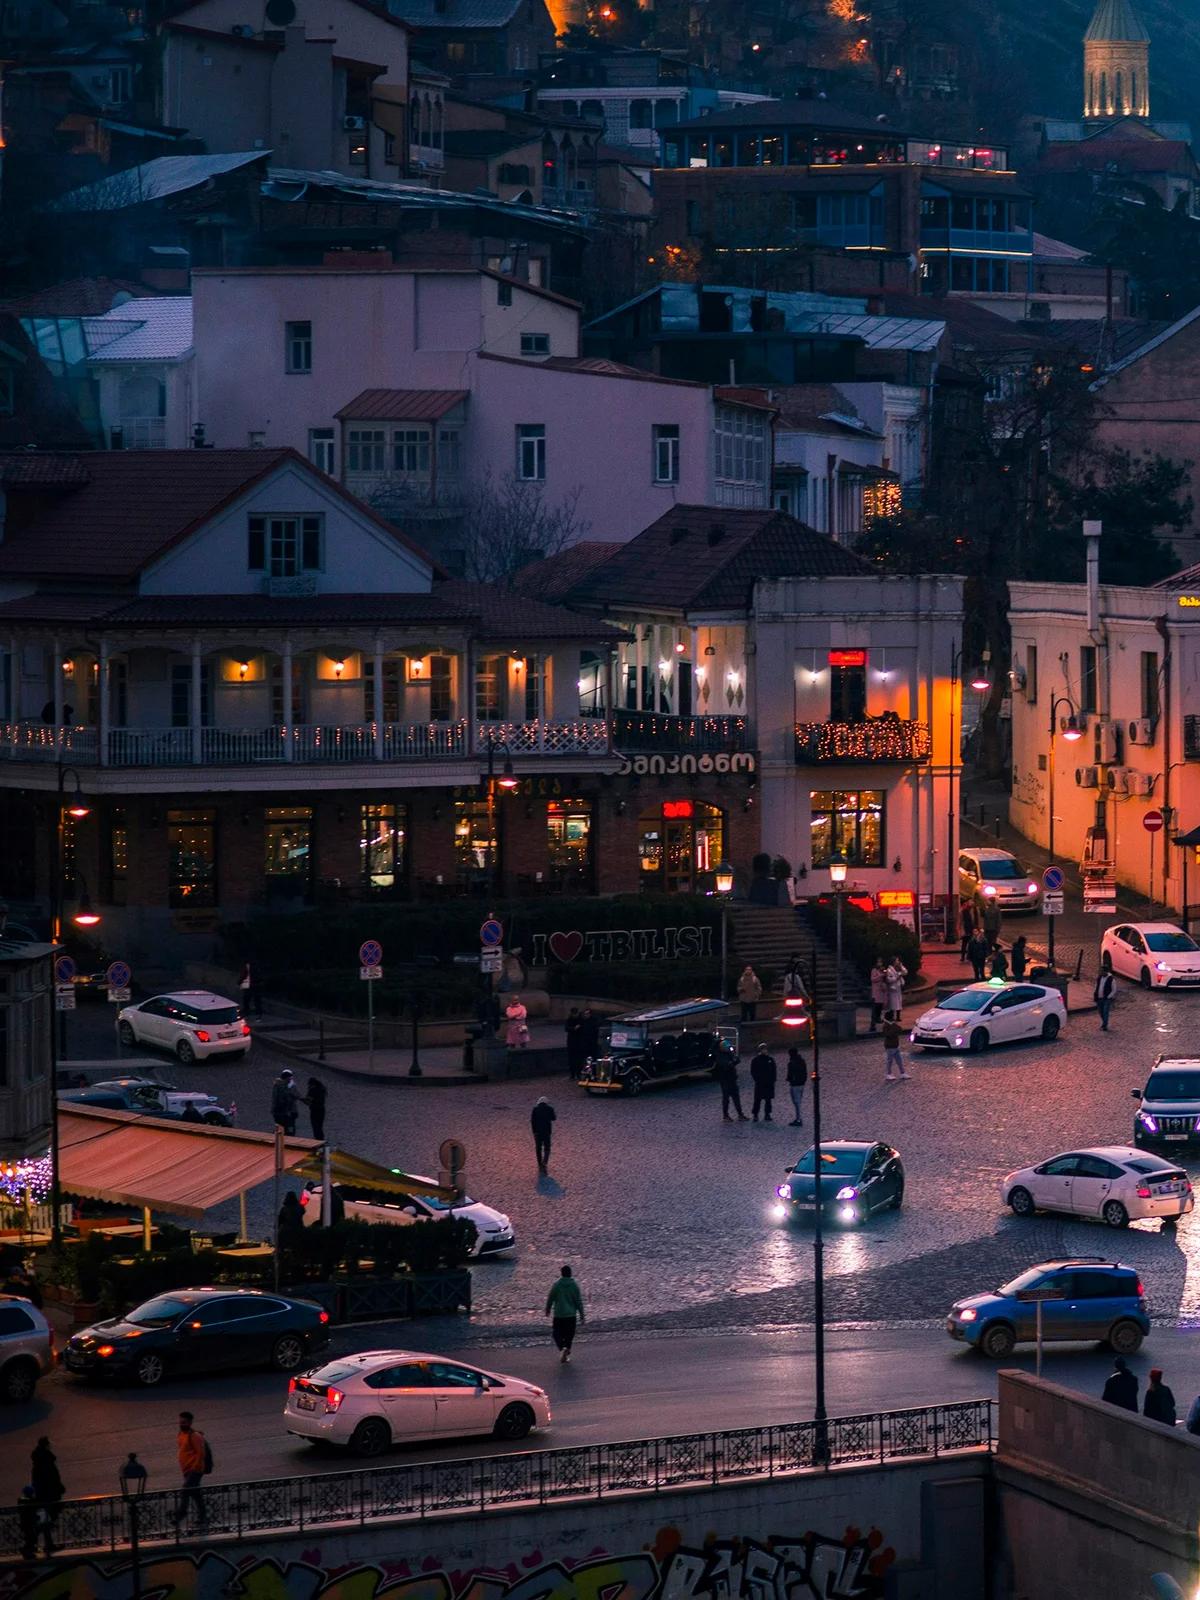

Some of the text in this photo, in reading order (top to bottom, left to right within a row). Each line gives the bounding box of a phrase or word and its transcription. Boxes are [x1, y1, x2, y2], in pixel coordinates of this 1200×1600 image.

[604, 753, 755, 776] ამიკიტნო
[531, 925, 713, 966] I TBILISI
